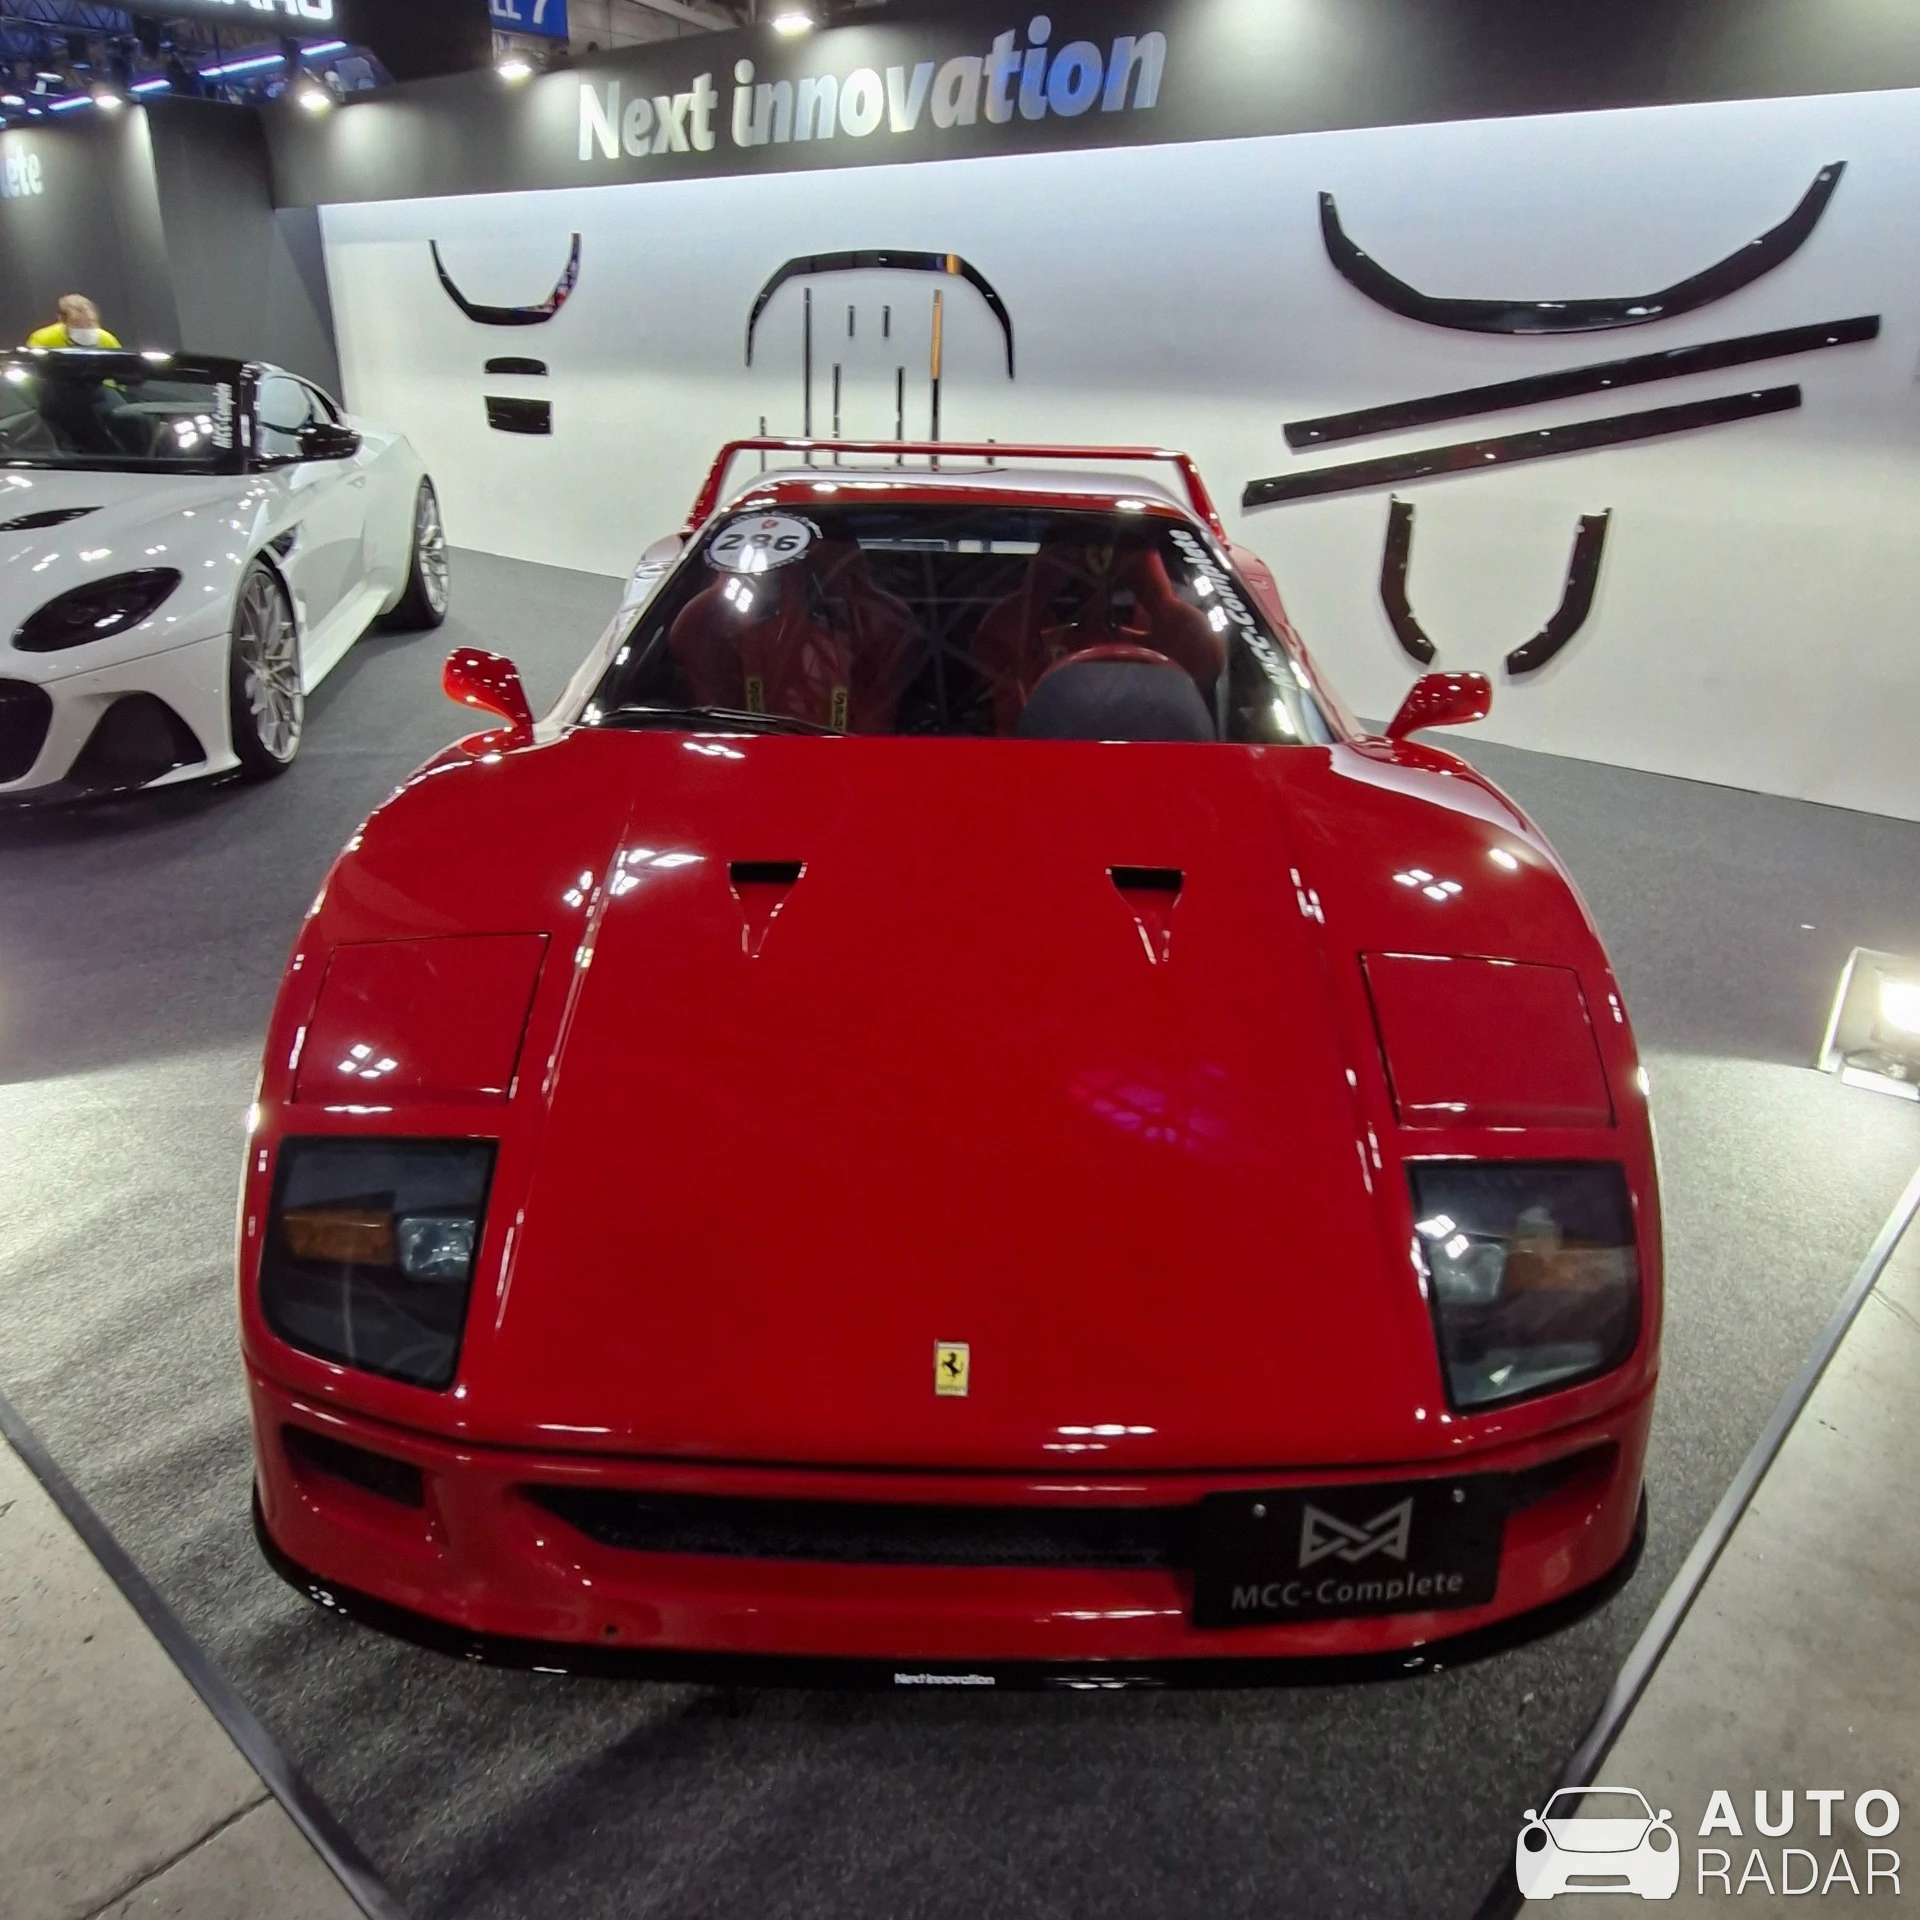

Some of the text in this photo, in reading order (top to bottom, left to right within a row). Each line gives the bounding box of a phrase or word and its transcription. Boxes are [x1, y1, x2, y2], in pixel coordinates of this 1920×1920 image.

[577, 15, 1166, 160] Next innovation
[712, 532, 801, 552] 286
[1169, 529, 1298, 692] MCC-Complete
[1230, 1571, 1466, 1610] MCC-Complete
